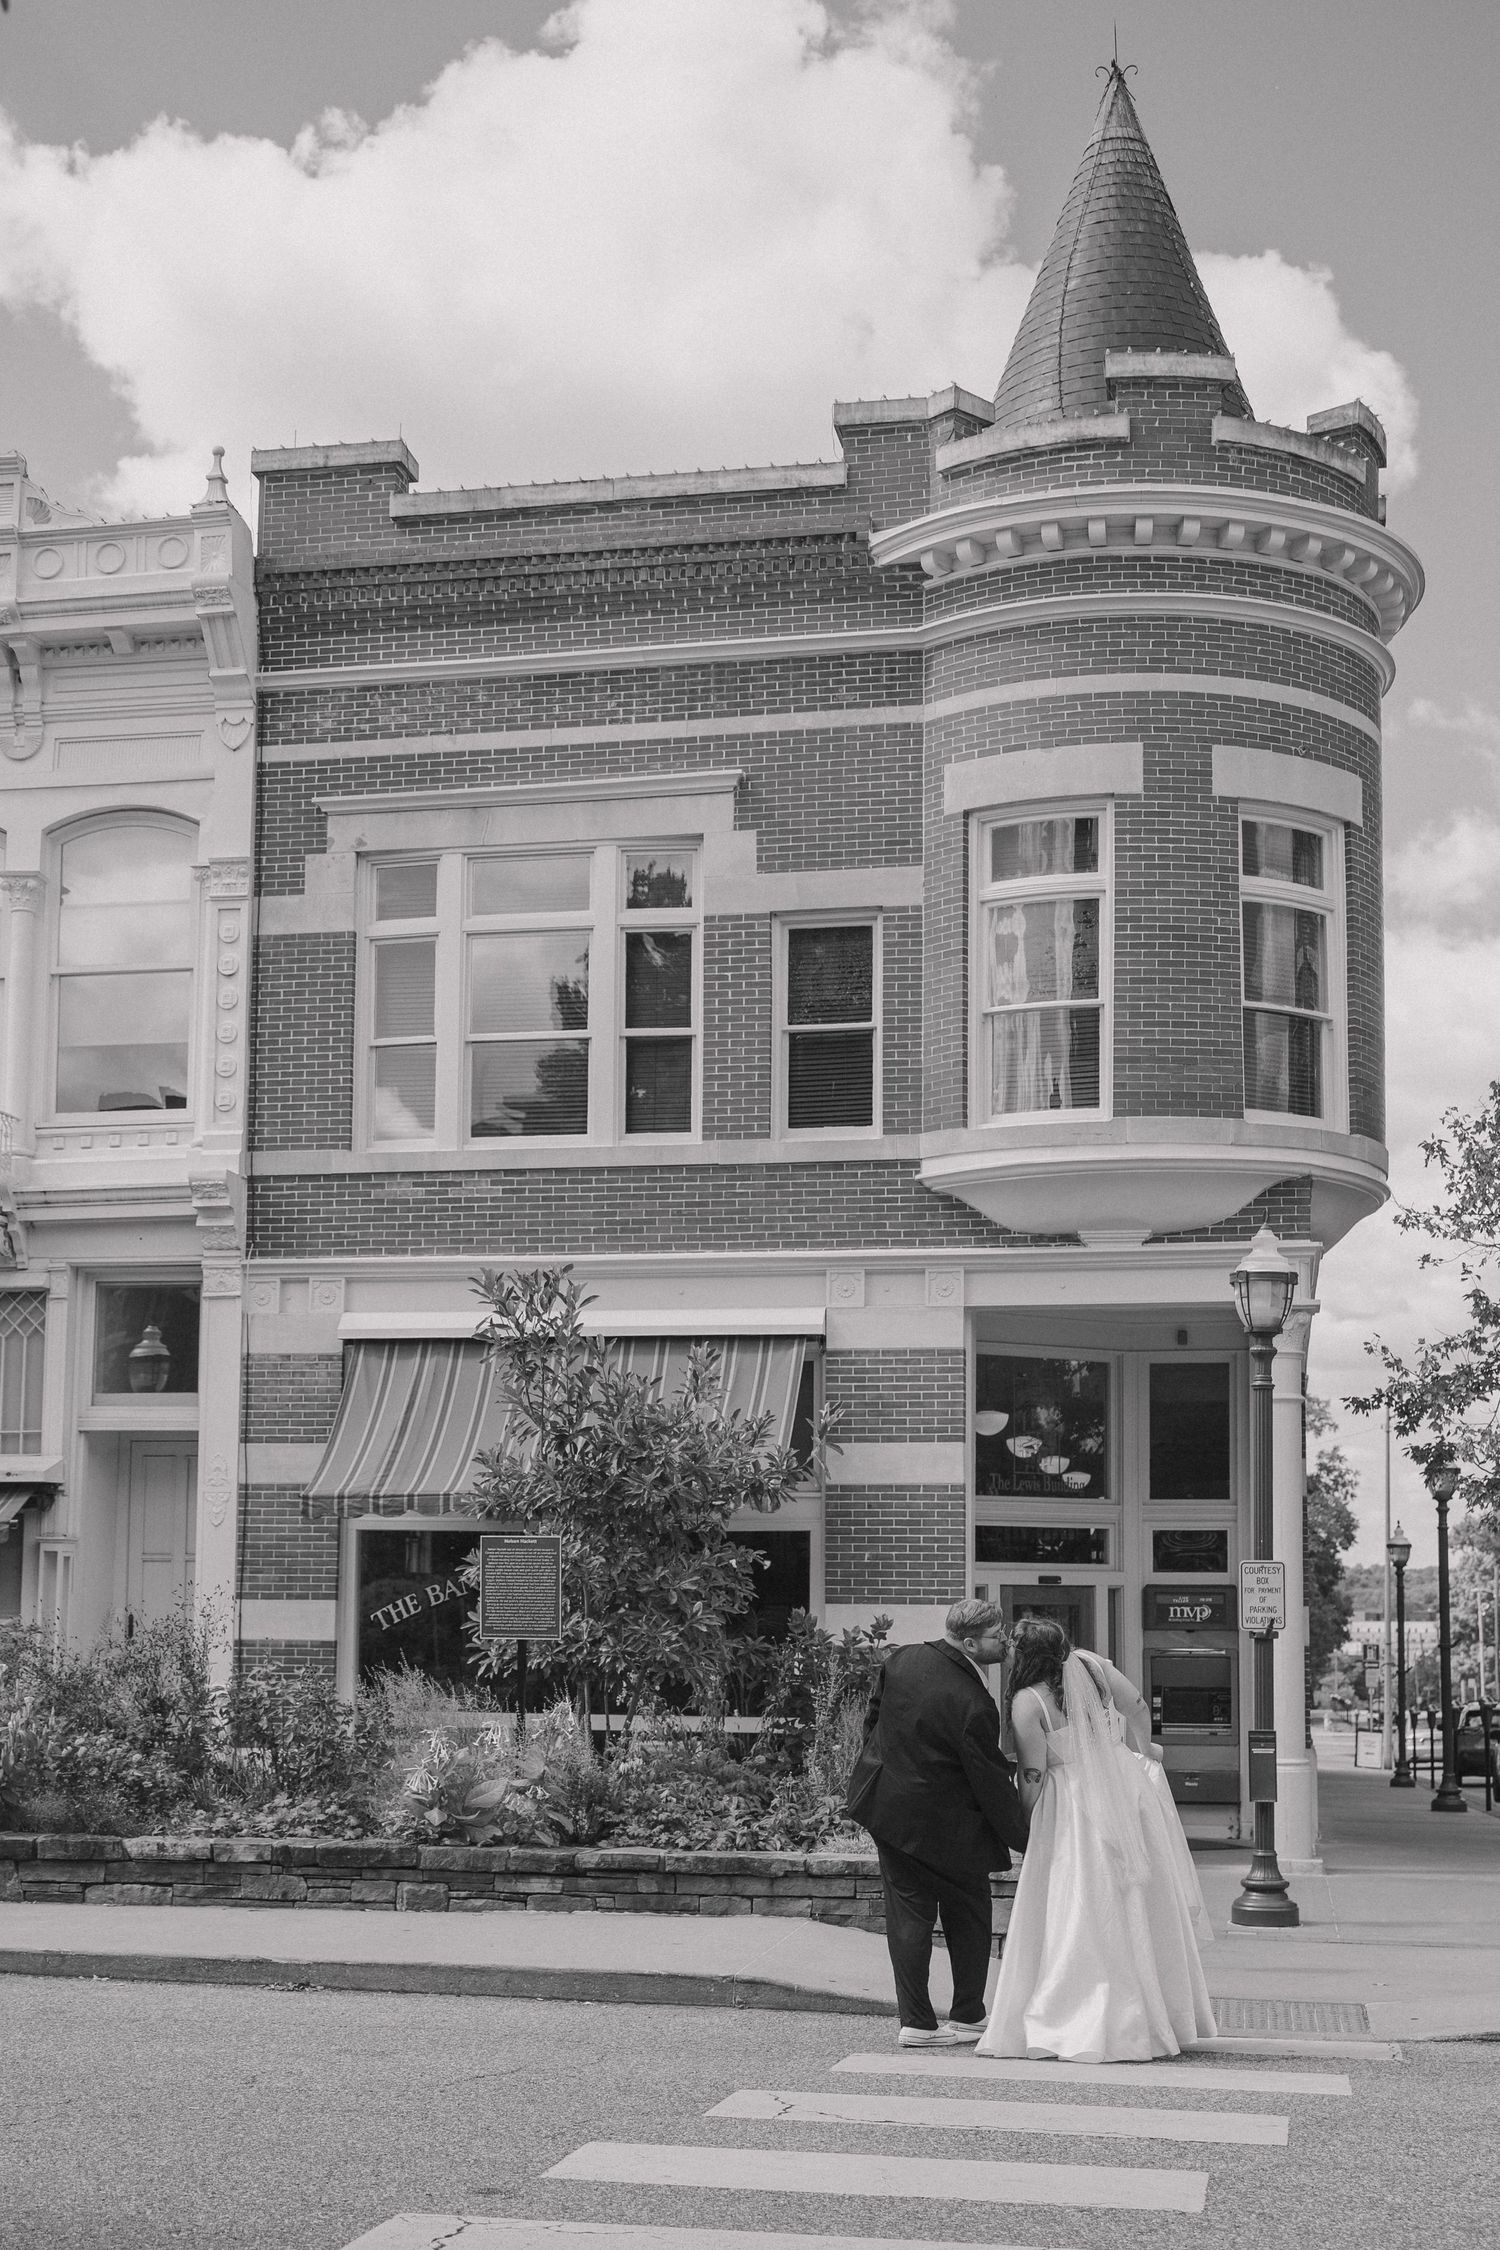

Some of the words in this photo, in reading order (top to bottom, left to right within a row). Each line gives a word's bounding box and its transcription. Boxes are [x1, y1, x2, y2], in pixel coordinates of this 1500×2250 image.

[989, 1473, 1010, 1490] The
[1013, 1474, 1040, 1491] Lewis
[1244, 1566, 1281, 1575] COURTESY
[1256, 1576, 1269, 1585] BOX
[370, 1593, 422, 1631] THE
[1168, 1604, 1212, 1622] mvp
[1249, 1605, 1277, 1614] PARKING
